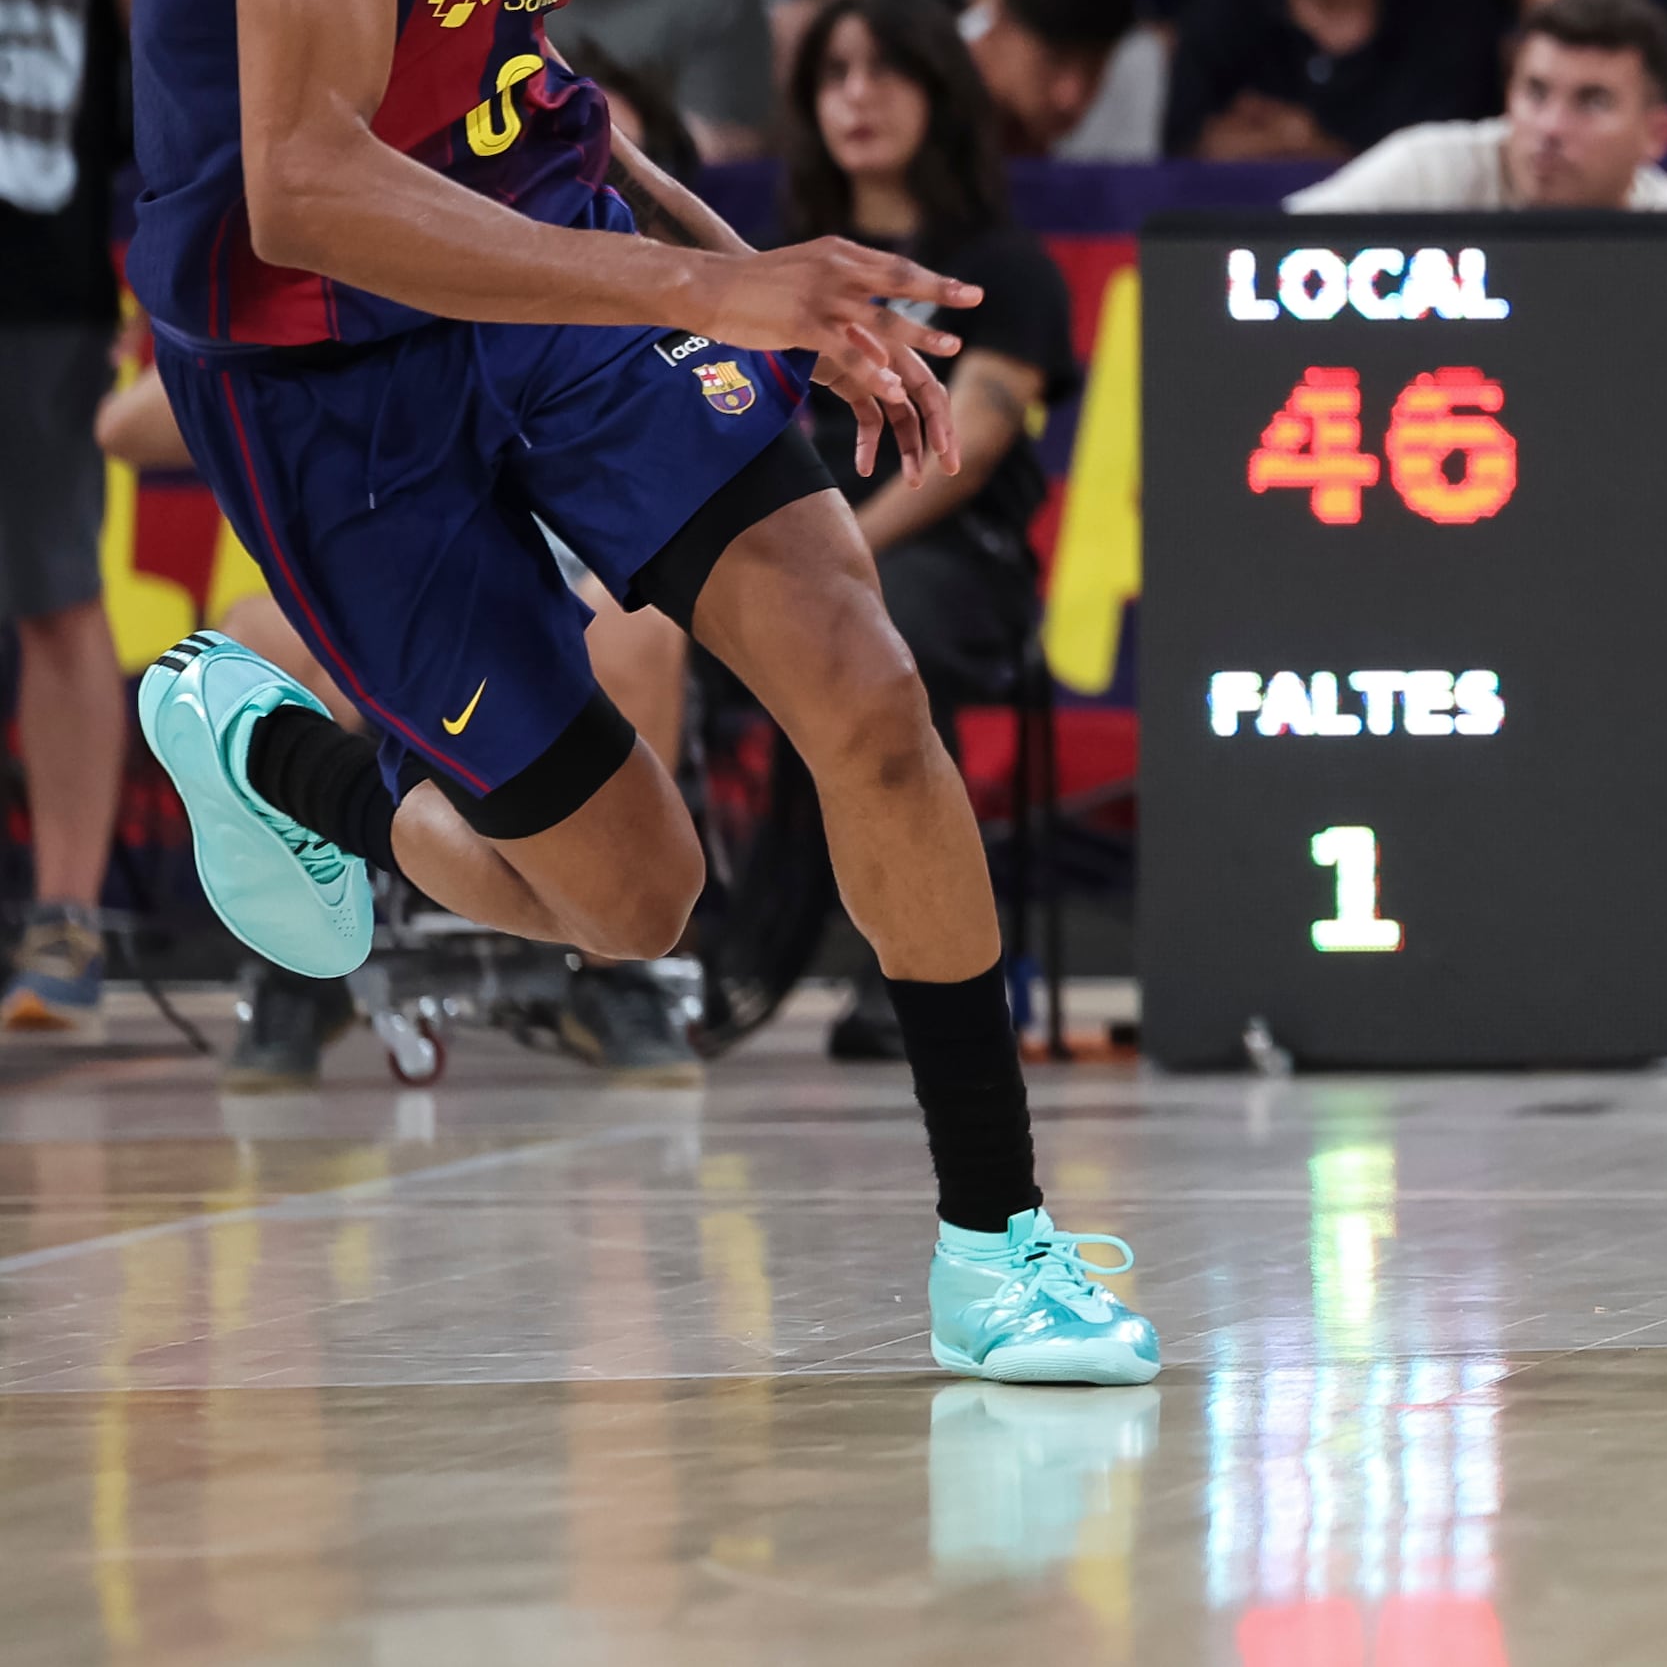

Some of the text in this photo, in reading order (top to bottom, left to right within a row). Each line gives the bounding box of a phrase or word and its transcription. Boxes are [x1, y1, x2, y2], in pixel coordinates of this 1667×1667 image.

[1227, 248, 1510, 320] LOCAL
[671, 335, 709, 360] acb
[1247, 366, 1518, 525] 46
[1206, 670, 1505, 736] FALTES
[1311, 826, 1404, 952] 1
